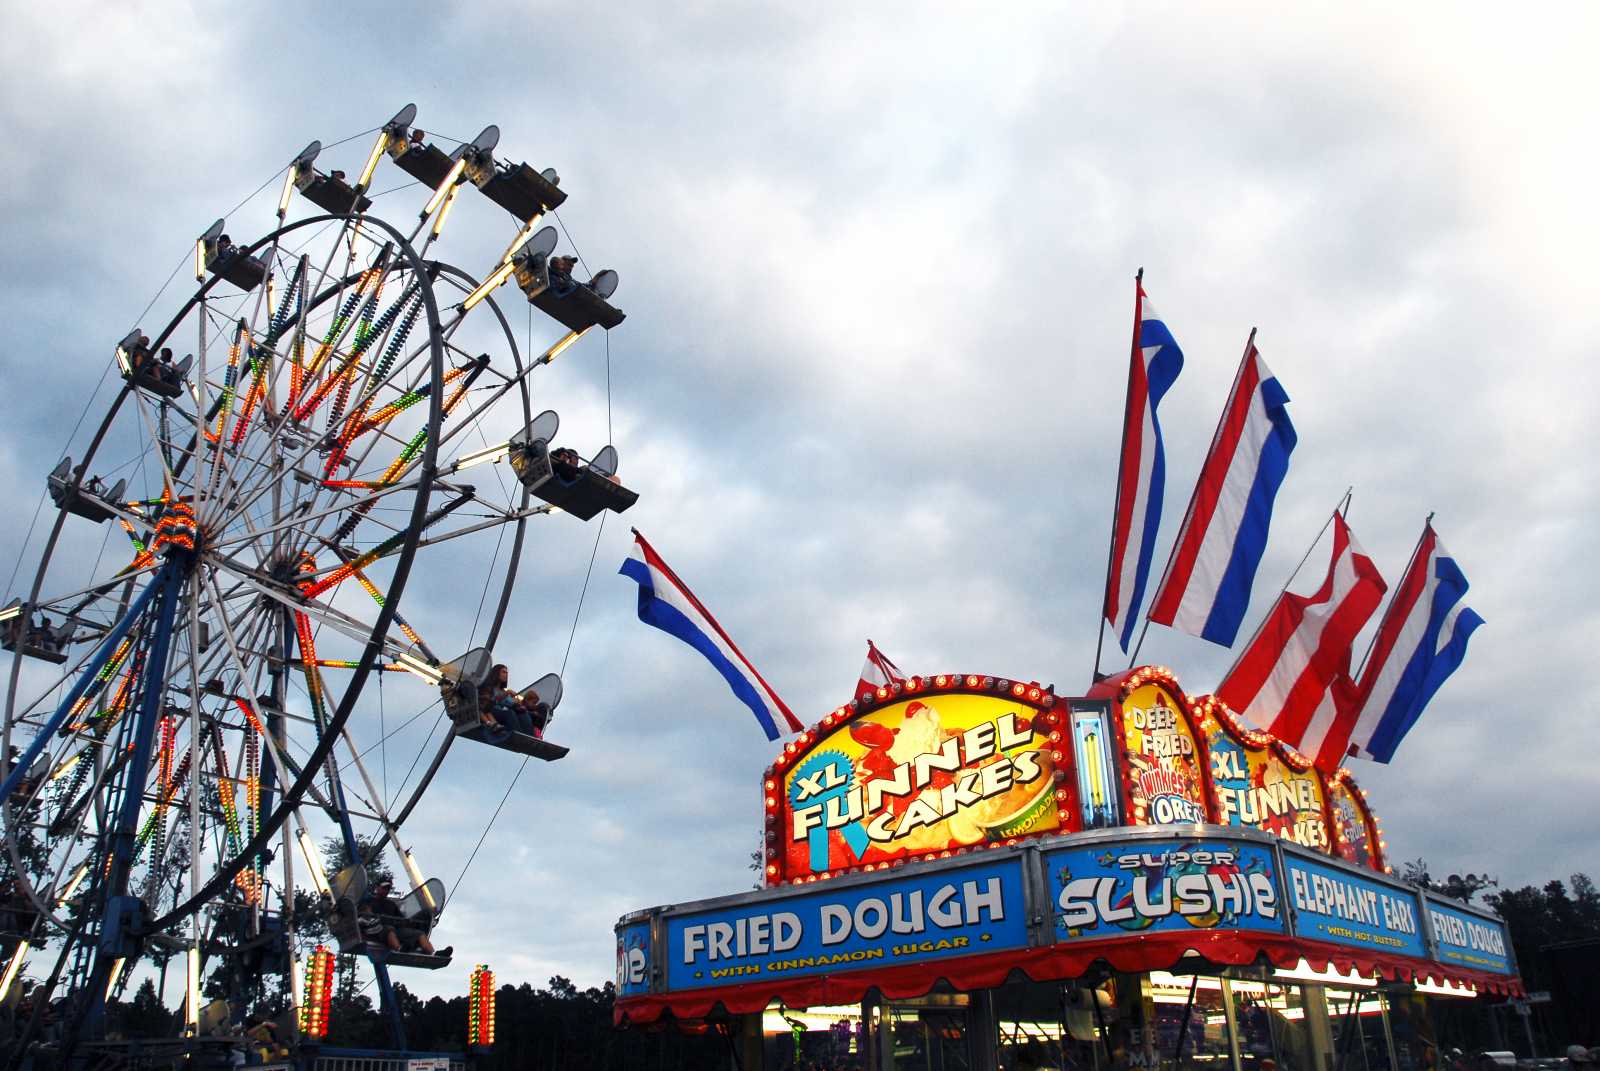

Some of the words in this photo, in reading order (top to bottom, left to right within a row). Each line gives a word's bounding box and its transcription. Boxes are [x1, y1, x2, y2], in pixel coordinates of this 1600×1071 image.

[1133, 707, 1177, 730] DEEP
[1142, 734, 1193, 758] FRIED
[1215, 750, 1246, 780] XL
[792, 712, 1034, 841] FUNNEL
[796, 762, 849, 800] XL
[866, 751, 1041, 843] CAKES
[1218, 779, 1321, 824] FUNNEL
[683, 910, 803, 965] FRIED
[819, 877, 1005, 945] DOUGH
[1291, 867, 1379, 928] ELEPHANT
[1381, 894, 1417, 936] EARS
[1327, 926, 1353, 938] WITH
[1355, 931, 1371, 942] HOT
[1430, 909, 1467, 948] FRIED
[1467, 921, 1507, 958] DOUGH
[710, 965, 760, 979] WITH
[767, 947, 884, 972] CINNAMON
[892, 936, 970, 957] SUGAR
